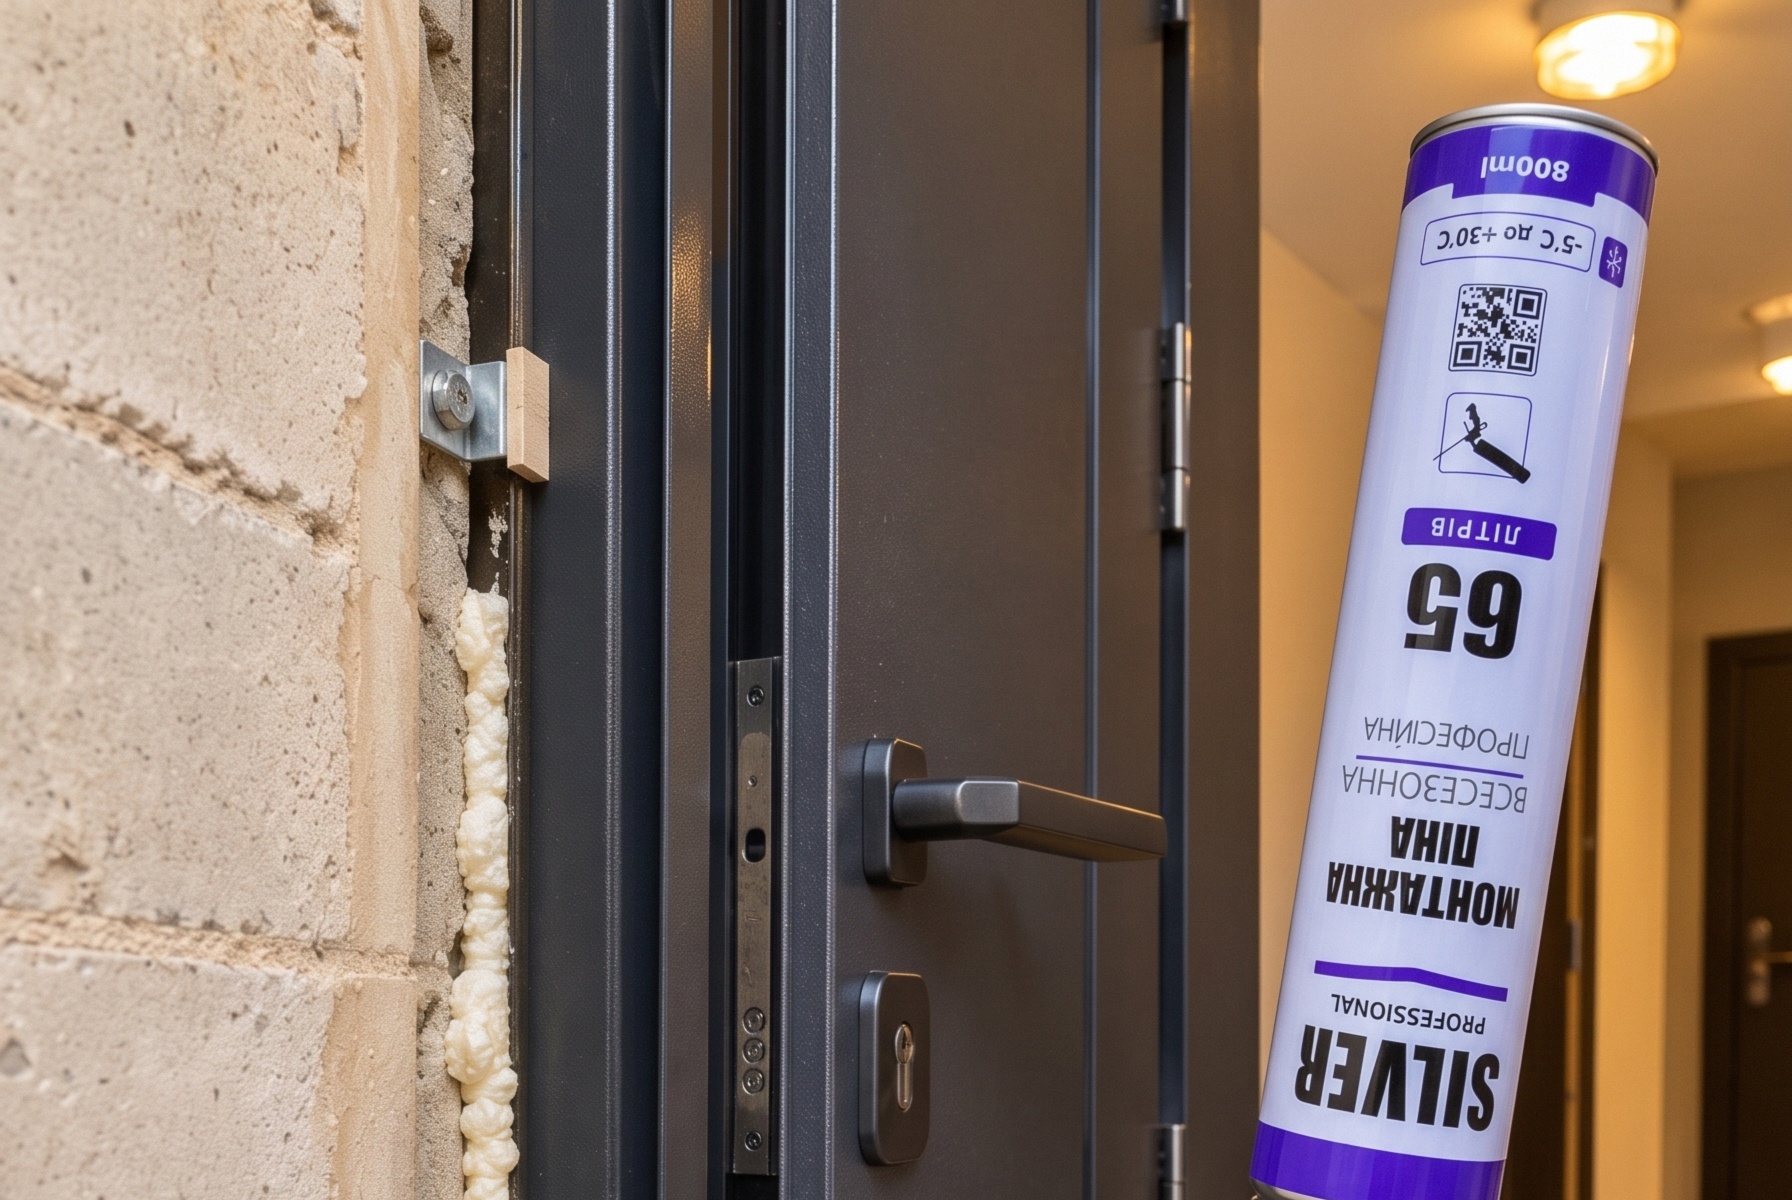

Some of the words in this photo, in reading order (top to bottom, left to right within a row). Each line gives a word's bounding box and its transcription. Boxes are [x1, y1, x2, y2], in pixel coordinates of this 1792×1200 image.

[1480, 155, 1570, 182] 800ml
[1504, 223, 1533, 241] до
[1431, 517, 1522, 545] ЛІТРІВ
[1403, 562, 1523, 660] 65
[1364, 716, 1531, 760] ПРОФЕСІЙНА
[1341, 764, 1528, 814] ВСЕСЕЗОННА
[1391, 815, 1480, 868] ПІНА
[1326, 861, 1521, 930] МОНТАЖНА
[1331, 993, 1486, 1035] PROFESSIONAL
[1294, 1024, 1500, 1132] SILVER
